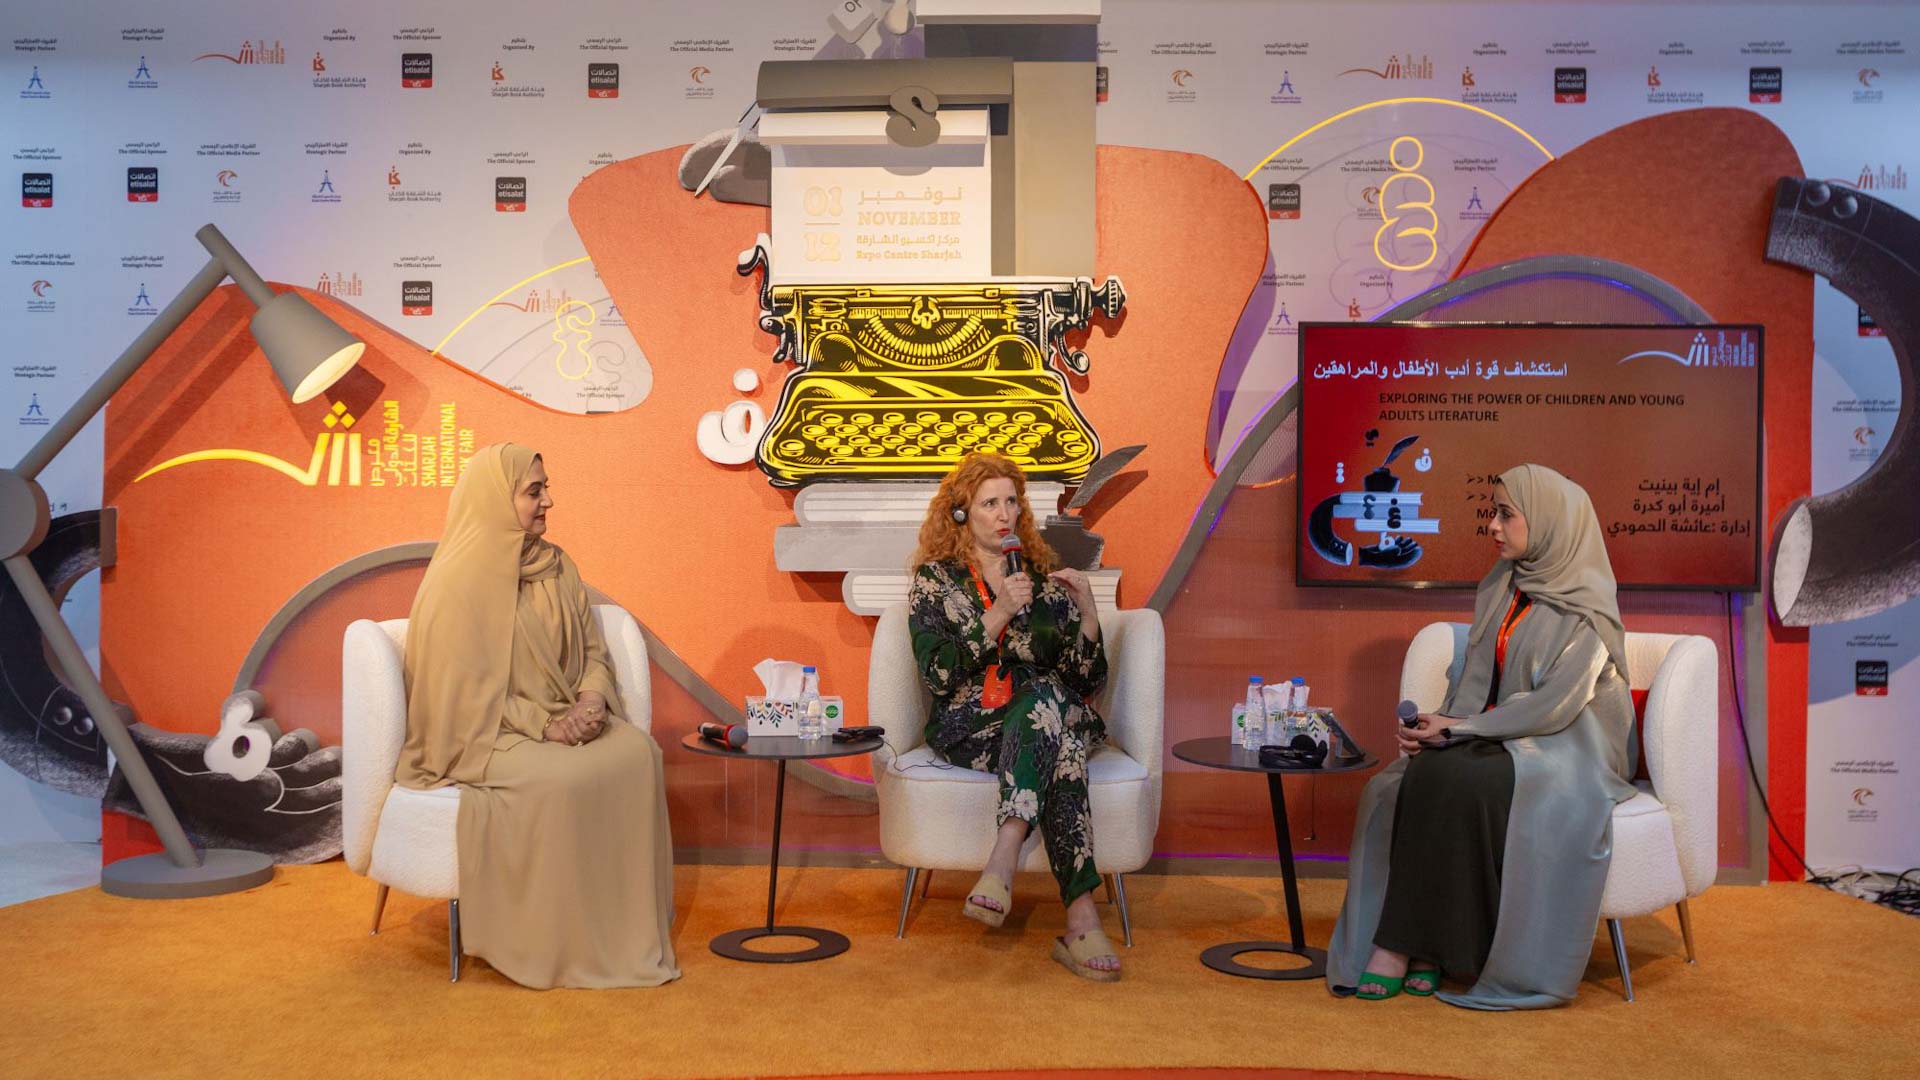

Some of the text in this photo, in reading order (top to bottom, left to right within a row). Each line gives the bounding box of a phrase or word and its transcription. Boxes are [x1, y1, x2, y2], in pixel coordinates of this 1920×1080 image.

[498, 190, 523, 198] etisalat
[858, 212, 961, 225] NOVEMBER
[856, 250, 962, 262] Expo Centre Sharjah
[1313, 359, 1568, 380] استكشاف قوة أدب الأطفال والمراهقين
[1379, 393, 1685, 406] EXPLORING THE POWER OF CHILDREN AND YOUNG
[1379, 411, 1499, 421] ADULTS LITERATURE
[440, 402, 456, 487] INTERNATIONAL
[459, 429, 473, 453] FAIR
[422, 436, 436, 487] SHARJAH
[1638, 479, 1677, 495] بينيت
[1705, 478, 1719, 498] إم
[1633, 495, 1725, 515] أميرة أبو كدرة
[1607, 519, 1666, 538] الحمودي
[1721, 520, 1751, 537] إدارة
